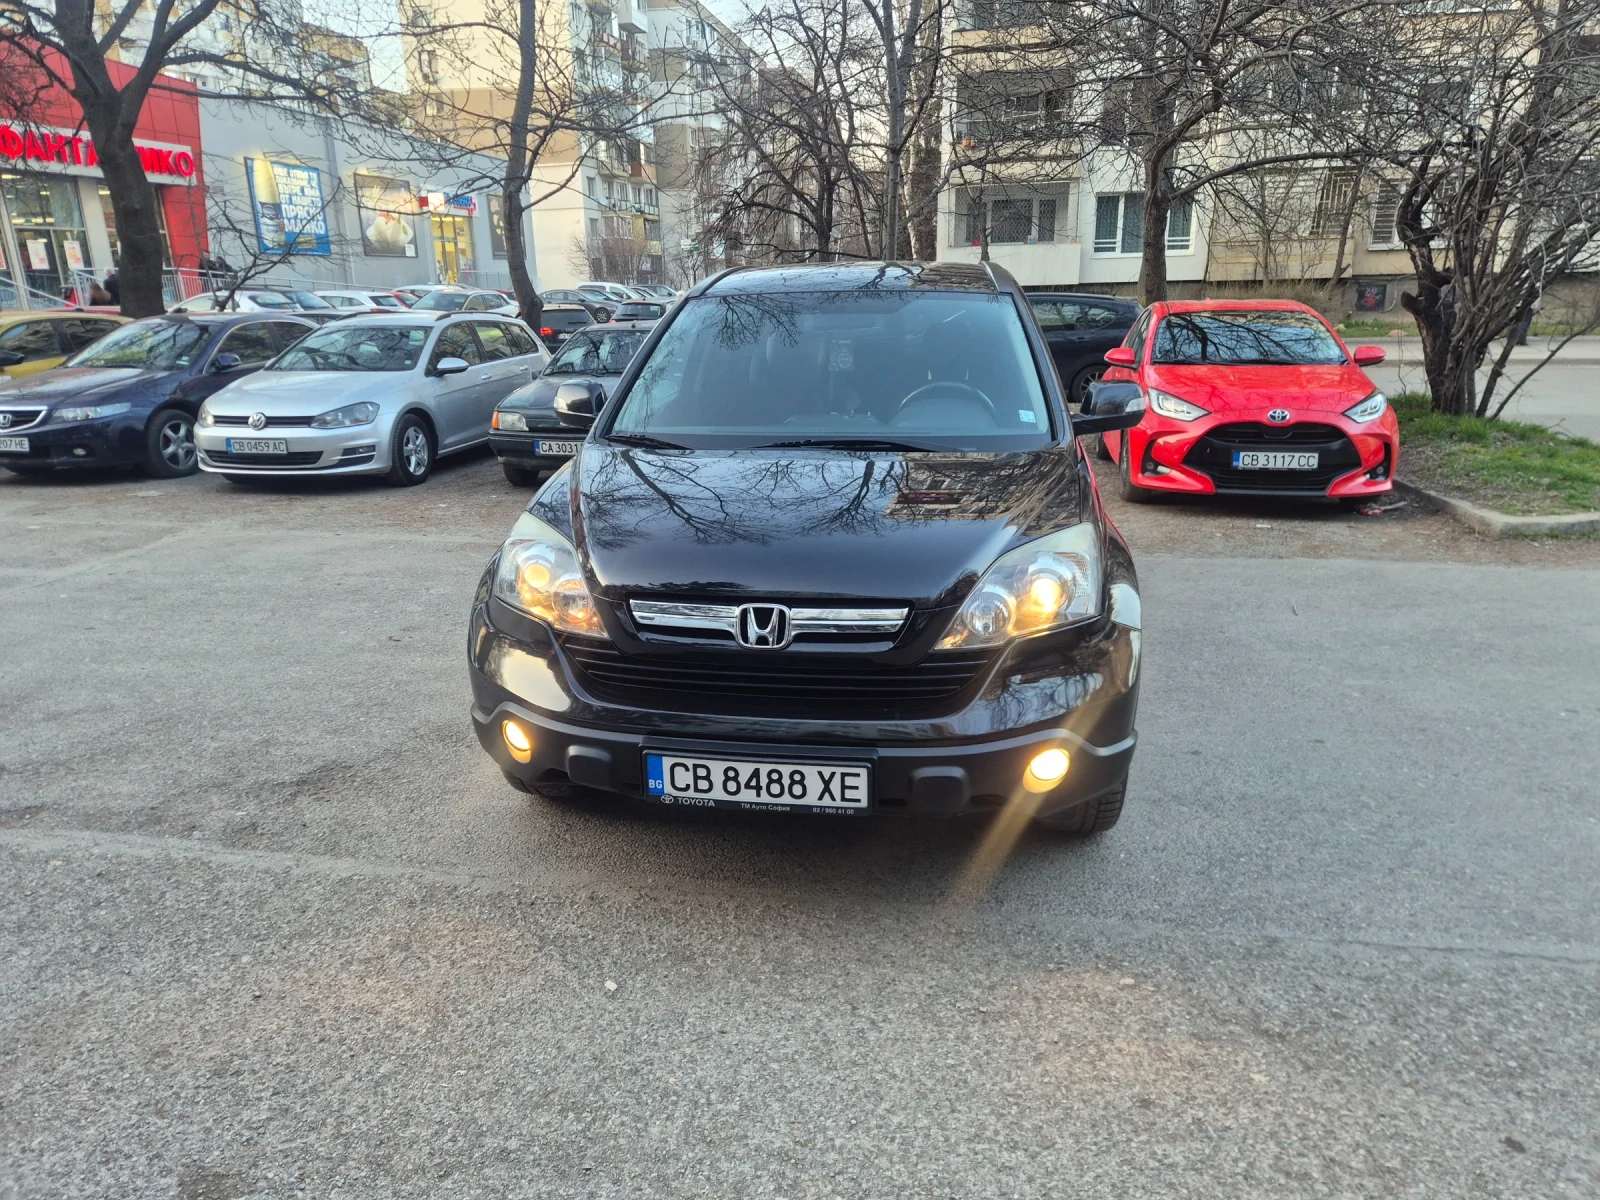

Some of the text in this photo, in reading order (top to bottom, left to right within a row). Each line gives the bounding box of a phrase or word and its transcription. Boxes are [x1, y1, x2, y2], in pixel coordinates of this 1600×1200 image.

[280, 194, 290, 204] ОТ
[281, 204, 324, 220] ПРЯСНО
[284, 218, 325, 234] МЛЯКО
[232, 441, 285, 452] CB 0459 AC
[541, 442, 554, 453] CA
[555, 443, 579, 454] 3031
[1242, 453, 1259, 467] CB
[1262, 454, 1295, 467] 3117
[1298, 454, 1316, 468] CC
[648, 779, 663, 789] BG
[669, 762, 862, 803] CB 8488 XE
[677, 797, 715, 807] TOYOTA
[768, 804, 791, 812] София
